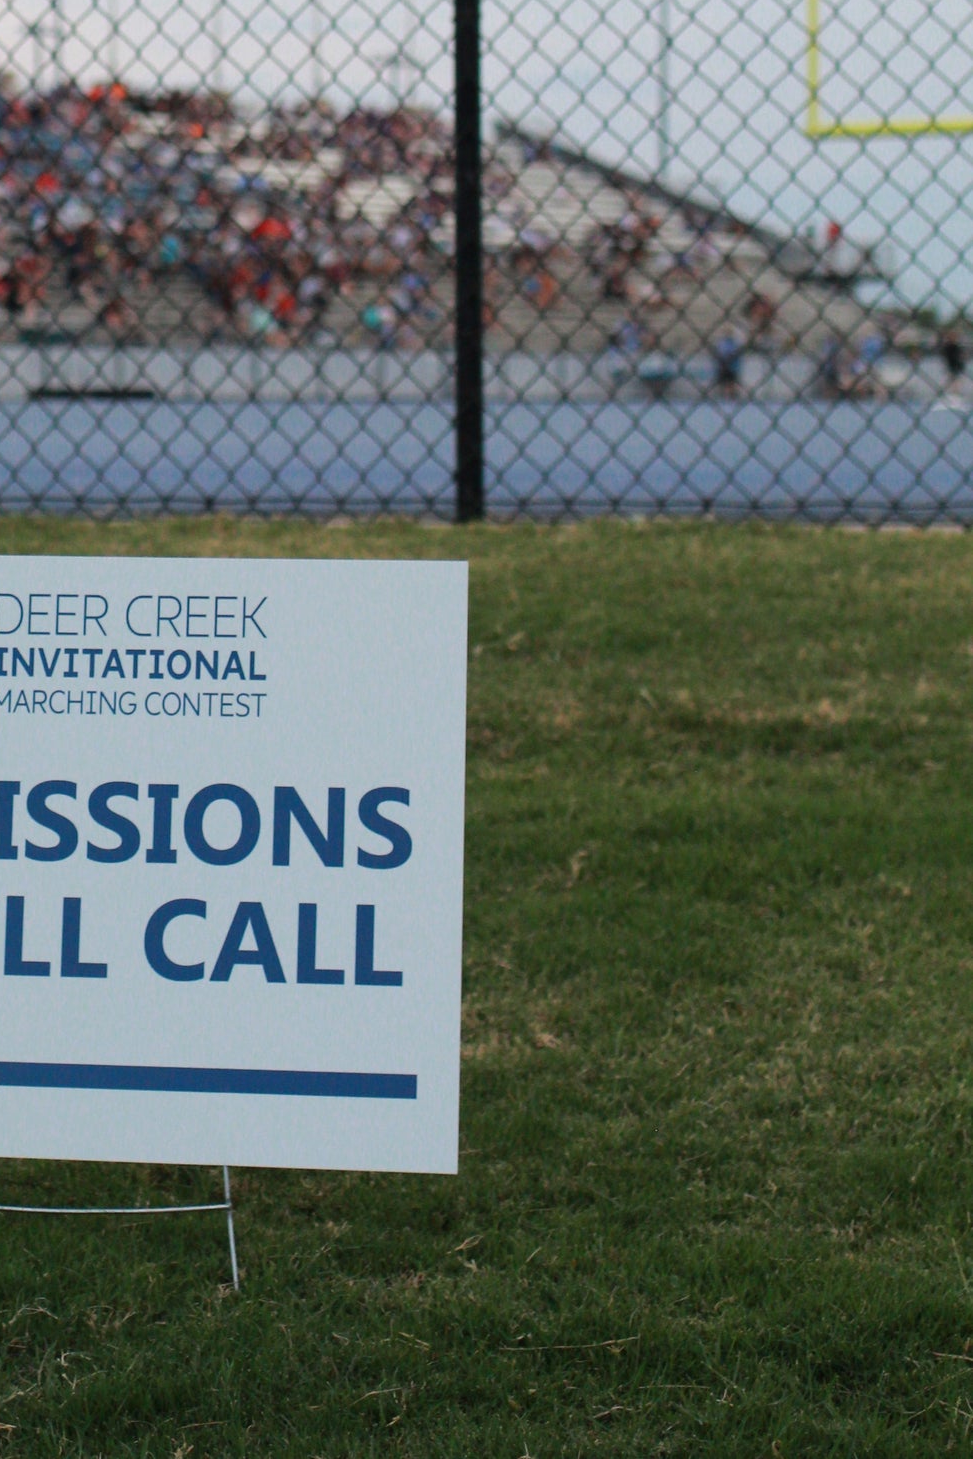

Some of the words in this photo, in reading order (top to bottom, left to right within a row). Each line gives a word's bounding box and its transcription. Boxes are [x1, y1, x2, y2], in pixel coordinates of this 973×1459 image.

[126, 595, 267, 638] CREEK
[145, 692, 267, 717] CONTEST
[144, 898, 403, 987] CALL
